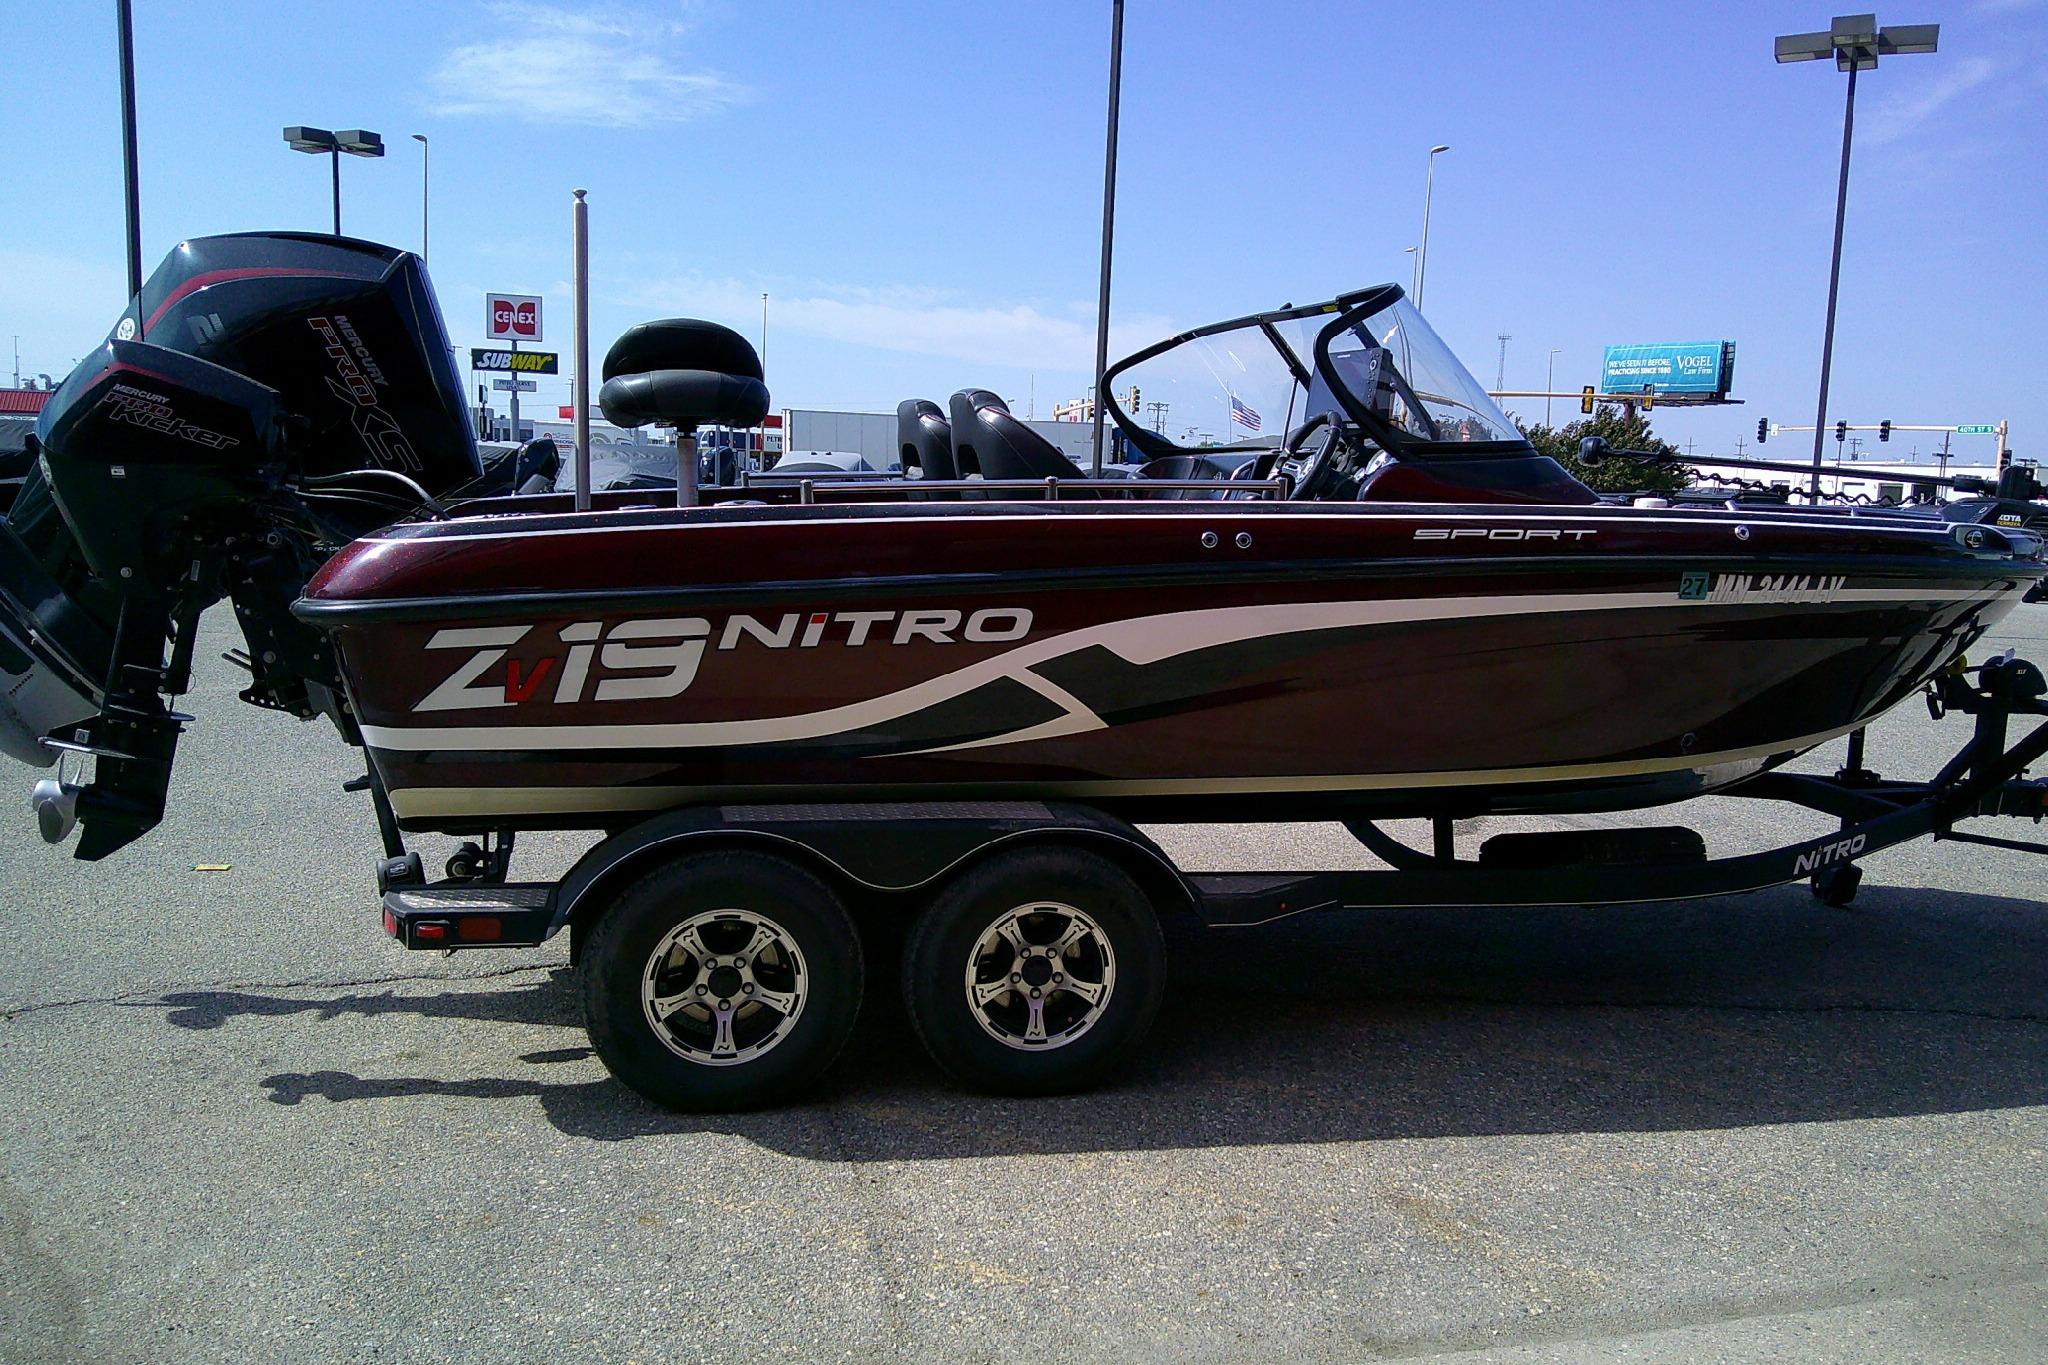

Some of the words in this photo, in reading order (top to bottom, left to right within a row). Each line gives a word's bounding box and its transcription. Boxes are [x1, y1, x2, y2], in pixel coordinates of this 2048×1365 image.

[495, 311, 535, 325] CENEX
[335, 315, 389, 386] MERCURY
[307, 317, 378, 406] PRO
[476, 351, 554, 371] SUBWAY
[1677, 355, 1713, 370] VOGEL
[1684, 367, 1697, 375] Law
[1697, 367, 1713, 375] Firm
[113, 383, 171, 404] MERCURY
[105, 391, 174, 419] PRO
[1413, 529, 1598, 541] SPORT
[1682, 577, 1707, 596] 27
[1709, 573, 1753, 604] MN
